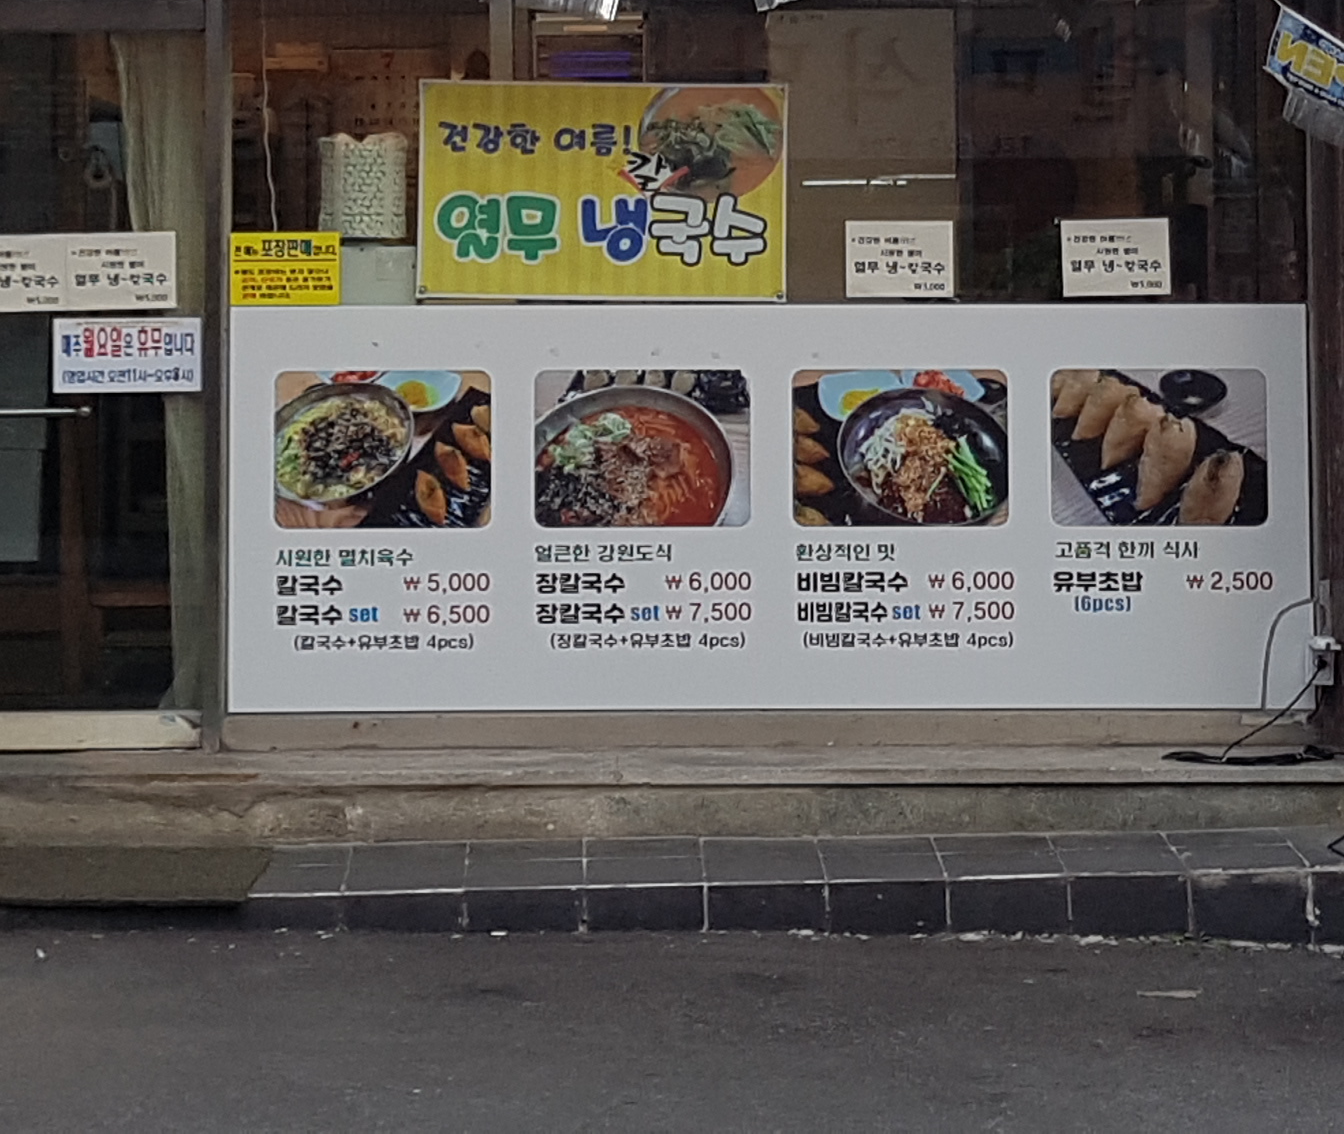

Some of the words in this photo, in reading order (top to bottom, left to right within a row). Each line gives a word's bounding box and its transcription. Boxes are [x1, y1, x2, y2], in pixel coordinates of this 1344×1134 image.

[439, 121, 540, 155] 건강한
[553, 123, 632, 156] 여름!
[435, 191, 560, 264] 열무
[276, 549, 331, 567] 시원한
[338, 549, 413, 567] 멸치육수
[598, 544, 672, 562] 강원도식
[796, 544, 870, 561] 환상적인
[877, 544, 895, 561] 맛
[1055, 542, 1110, 559] 고품격
[1118, 542, 1154, 558] 한끼
[1163, 542, 1199, 558] 식사
[276, 575, 343, 596] 칼국수
[427, 573, 490, 594] 5,000
[536, 573, 625, 594] 장칼국수
[689, 572, 751, 593] 6,000
[797, 572, 908, 592] 비빔칼국수
[952, 572, 1014, 593] 6,000
[1053, 572, 1143, 592] 유부초밥
[1210, 572, 1273, 593] 2,500
[536, 603, 625, 624] 장칼국수
[631, 605, 660, 621] set
[689, 603, 751, 623] 7,500
[797, 601, 887, 622] 비빔칼국수
[892, 604, 921, 620] set
[952, 601, 1014, 623] 7,500
[1074, 596, 1131, 612] (6pcs)
[276, 605, 343, 626] 칼국수
[349, 607, 379, 622] set
[427, 605, 490, 626] 6,500
[427, 633, 474, 651] 4pcs)
[699, 632, 745, 649] 4pcs)
[966, 632, 1013, 649] 4pcs)
